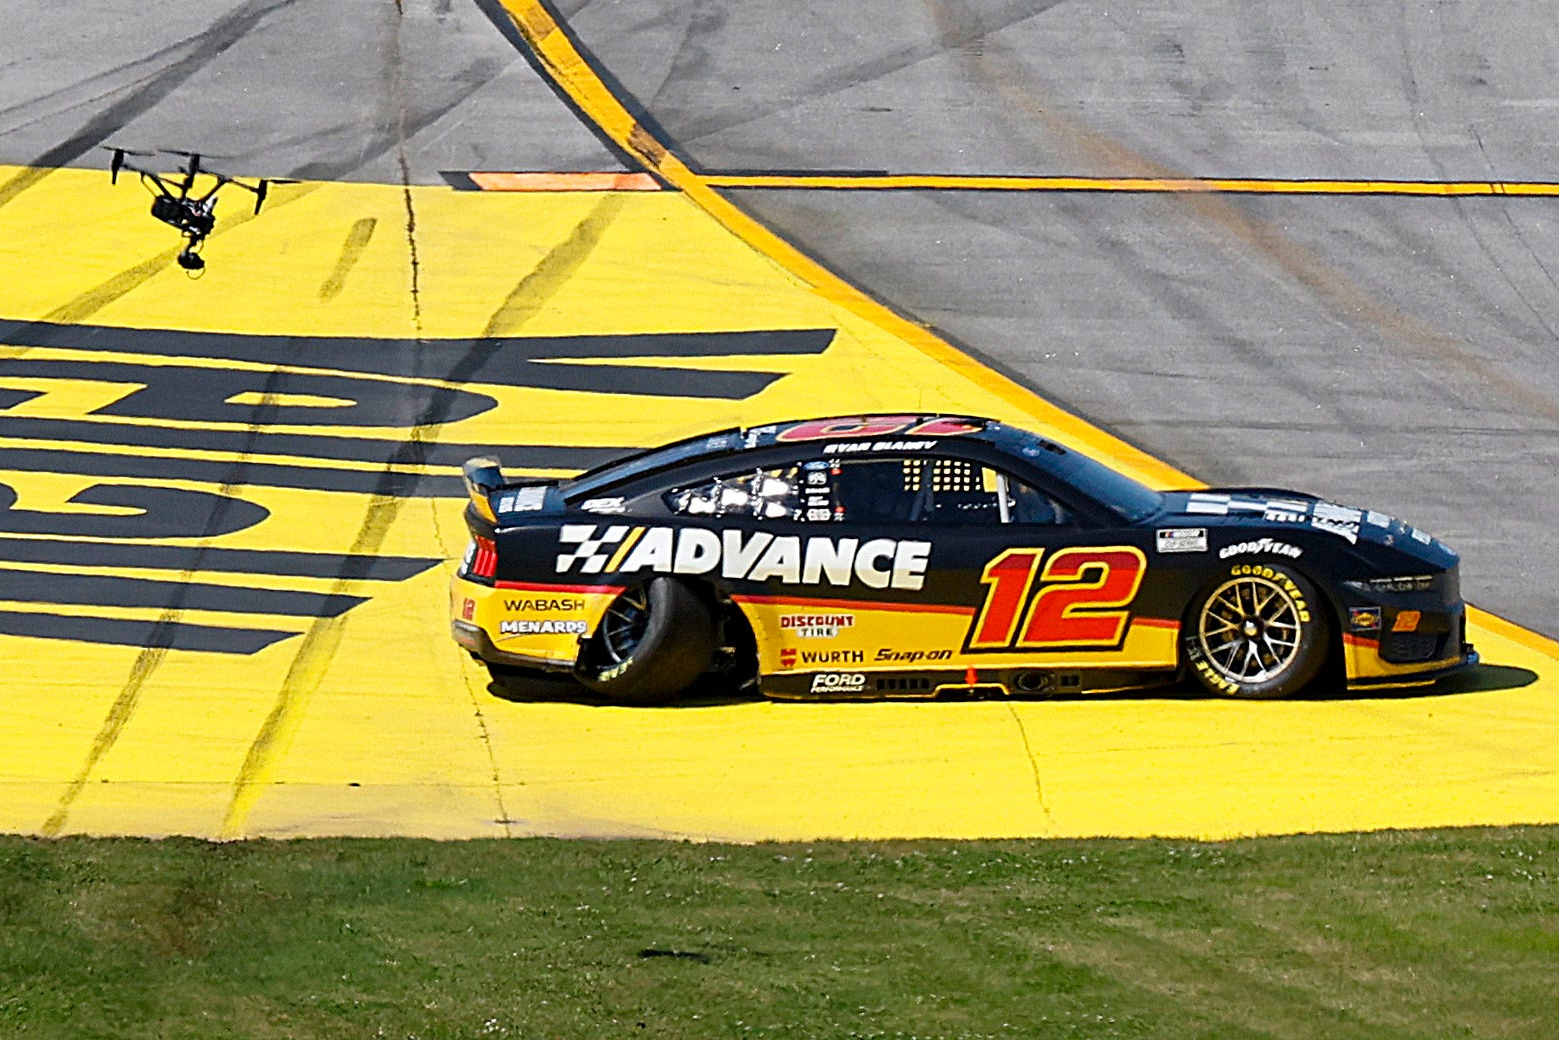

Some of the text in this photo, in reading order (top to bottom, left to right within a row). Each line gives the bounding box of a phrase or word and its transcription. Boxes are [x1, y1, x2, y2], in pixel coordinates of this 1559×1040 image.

[1219, 538, 1303, 559] GOODYEAR
[619, 526, 931, 591] ADVANCE
[968, 544, 1147, 650] 12
[504, 599, 586, 612] WABASH
[499, 620, 588, 634] MENARDS
[780, 615, 854, 628] DISCOUNT
[801, 628, 834, 637] TIRE
[874, 648, 953, 663] Snap-on
[812, 673, 866, 686] FORD
